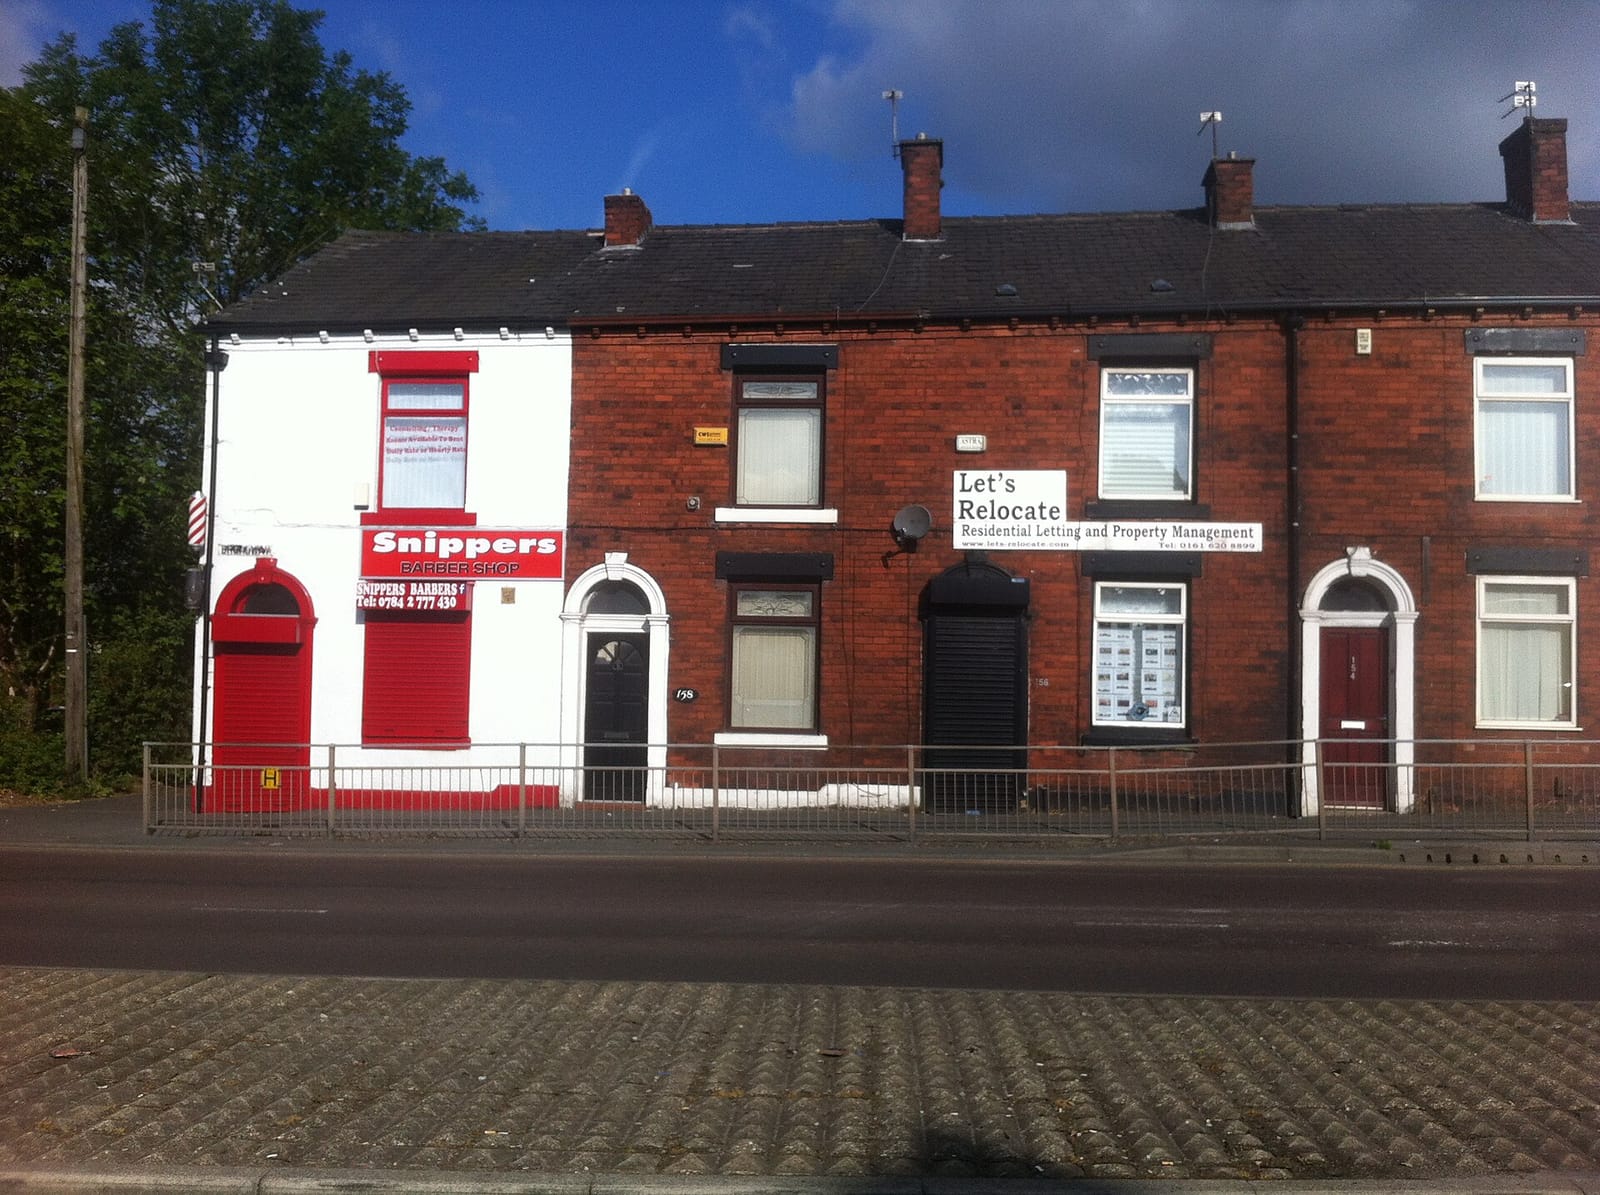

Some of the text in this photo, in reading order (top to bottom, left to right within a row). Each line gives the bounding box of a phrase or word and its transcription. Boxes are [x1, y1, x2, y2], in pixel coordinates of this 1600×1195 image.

[959, 471, 1016, 493] Let's
[958, 499, 1061, 521] Relocate
[962, 524, 1254, 541] Residential Letting and Property Management
[372, 531, 557, 559] Snippers
[400, 561, 520, 575] BARBER SHOP
[356, 582, 406, 595] SNIPPERS
[410, 582, 457, 596] BARBERS
[356, 595, 457, 609] Tel: 0784 2 777 430
[676, 689, 694, 701] 158
